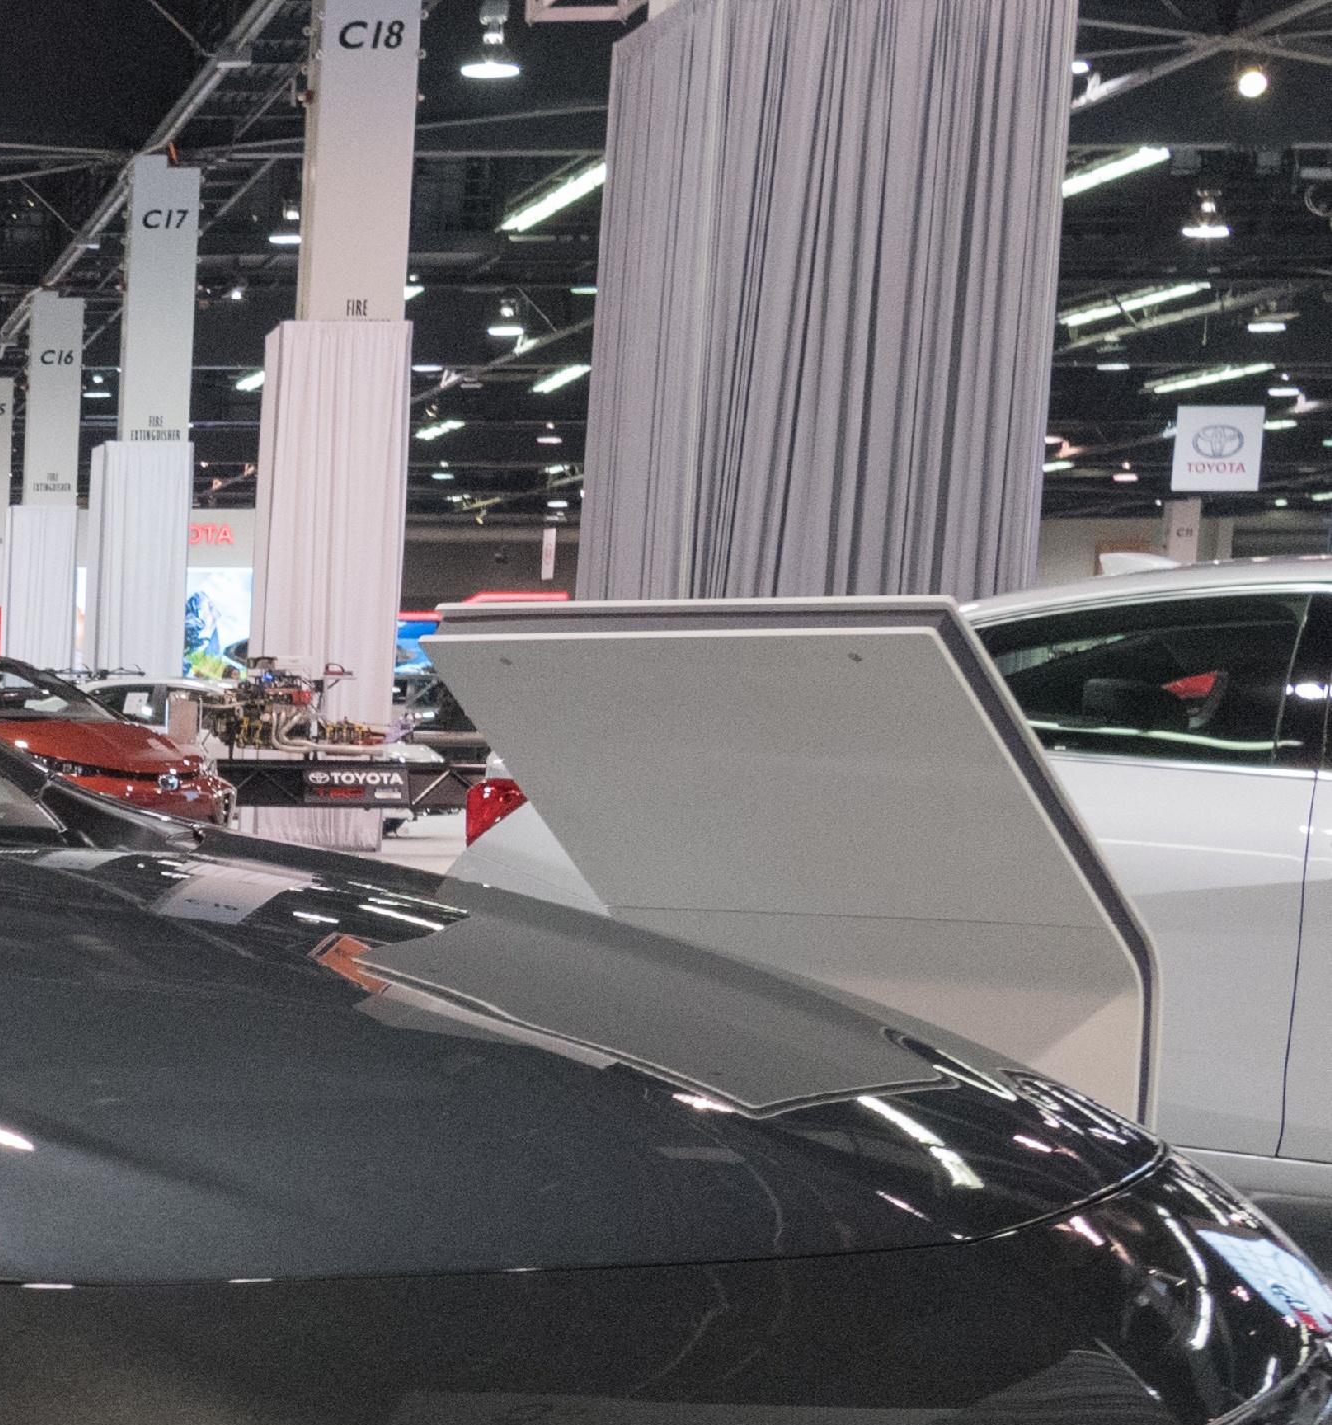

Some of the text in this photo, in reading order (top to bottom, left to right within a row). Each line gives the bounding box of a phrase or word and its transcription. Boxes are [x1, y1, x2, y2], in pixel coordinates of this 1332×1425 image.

[338, 19, 405, 49] C18
[141, 209, 189, 229] C17
[345, 299, 368, 317] FIRE
[40, 349, 75, 365] C16
[148, 416, 164, 427] FIRE
[130, 430, 181, 440] EXTINGUISHER
[1187, 463, 1246, 473] TOYOTA
[331, 772, 403, 784] TOYOTA
